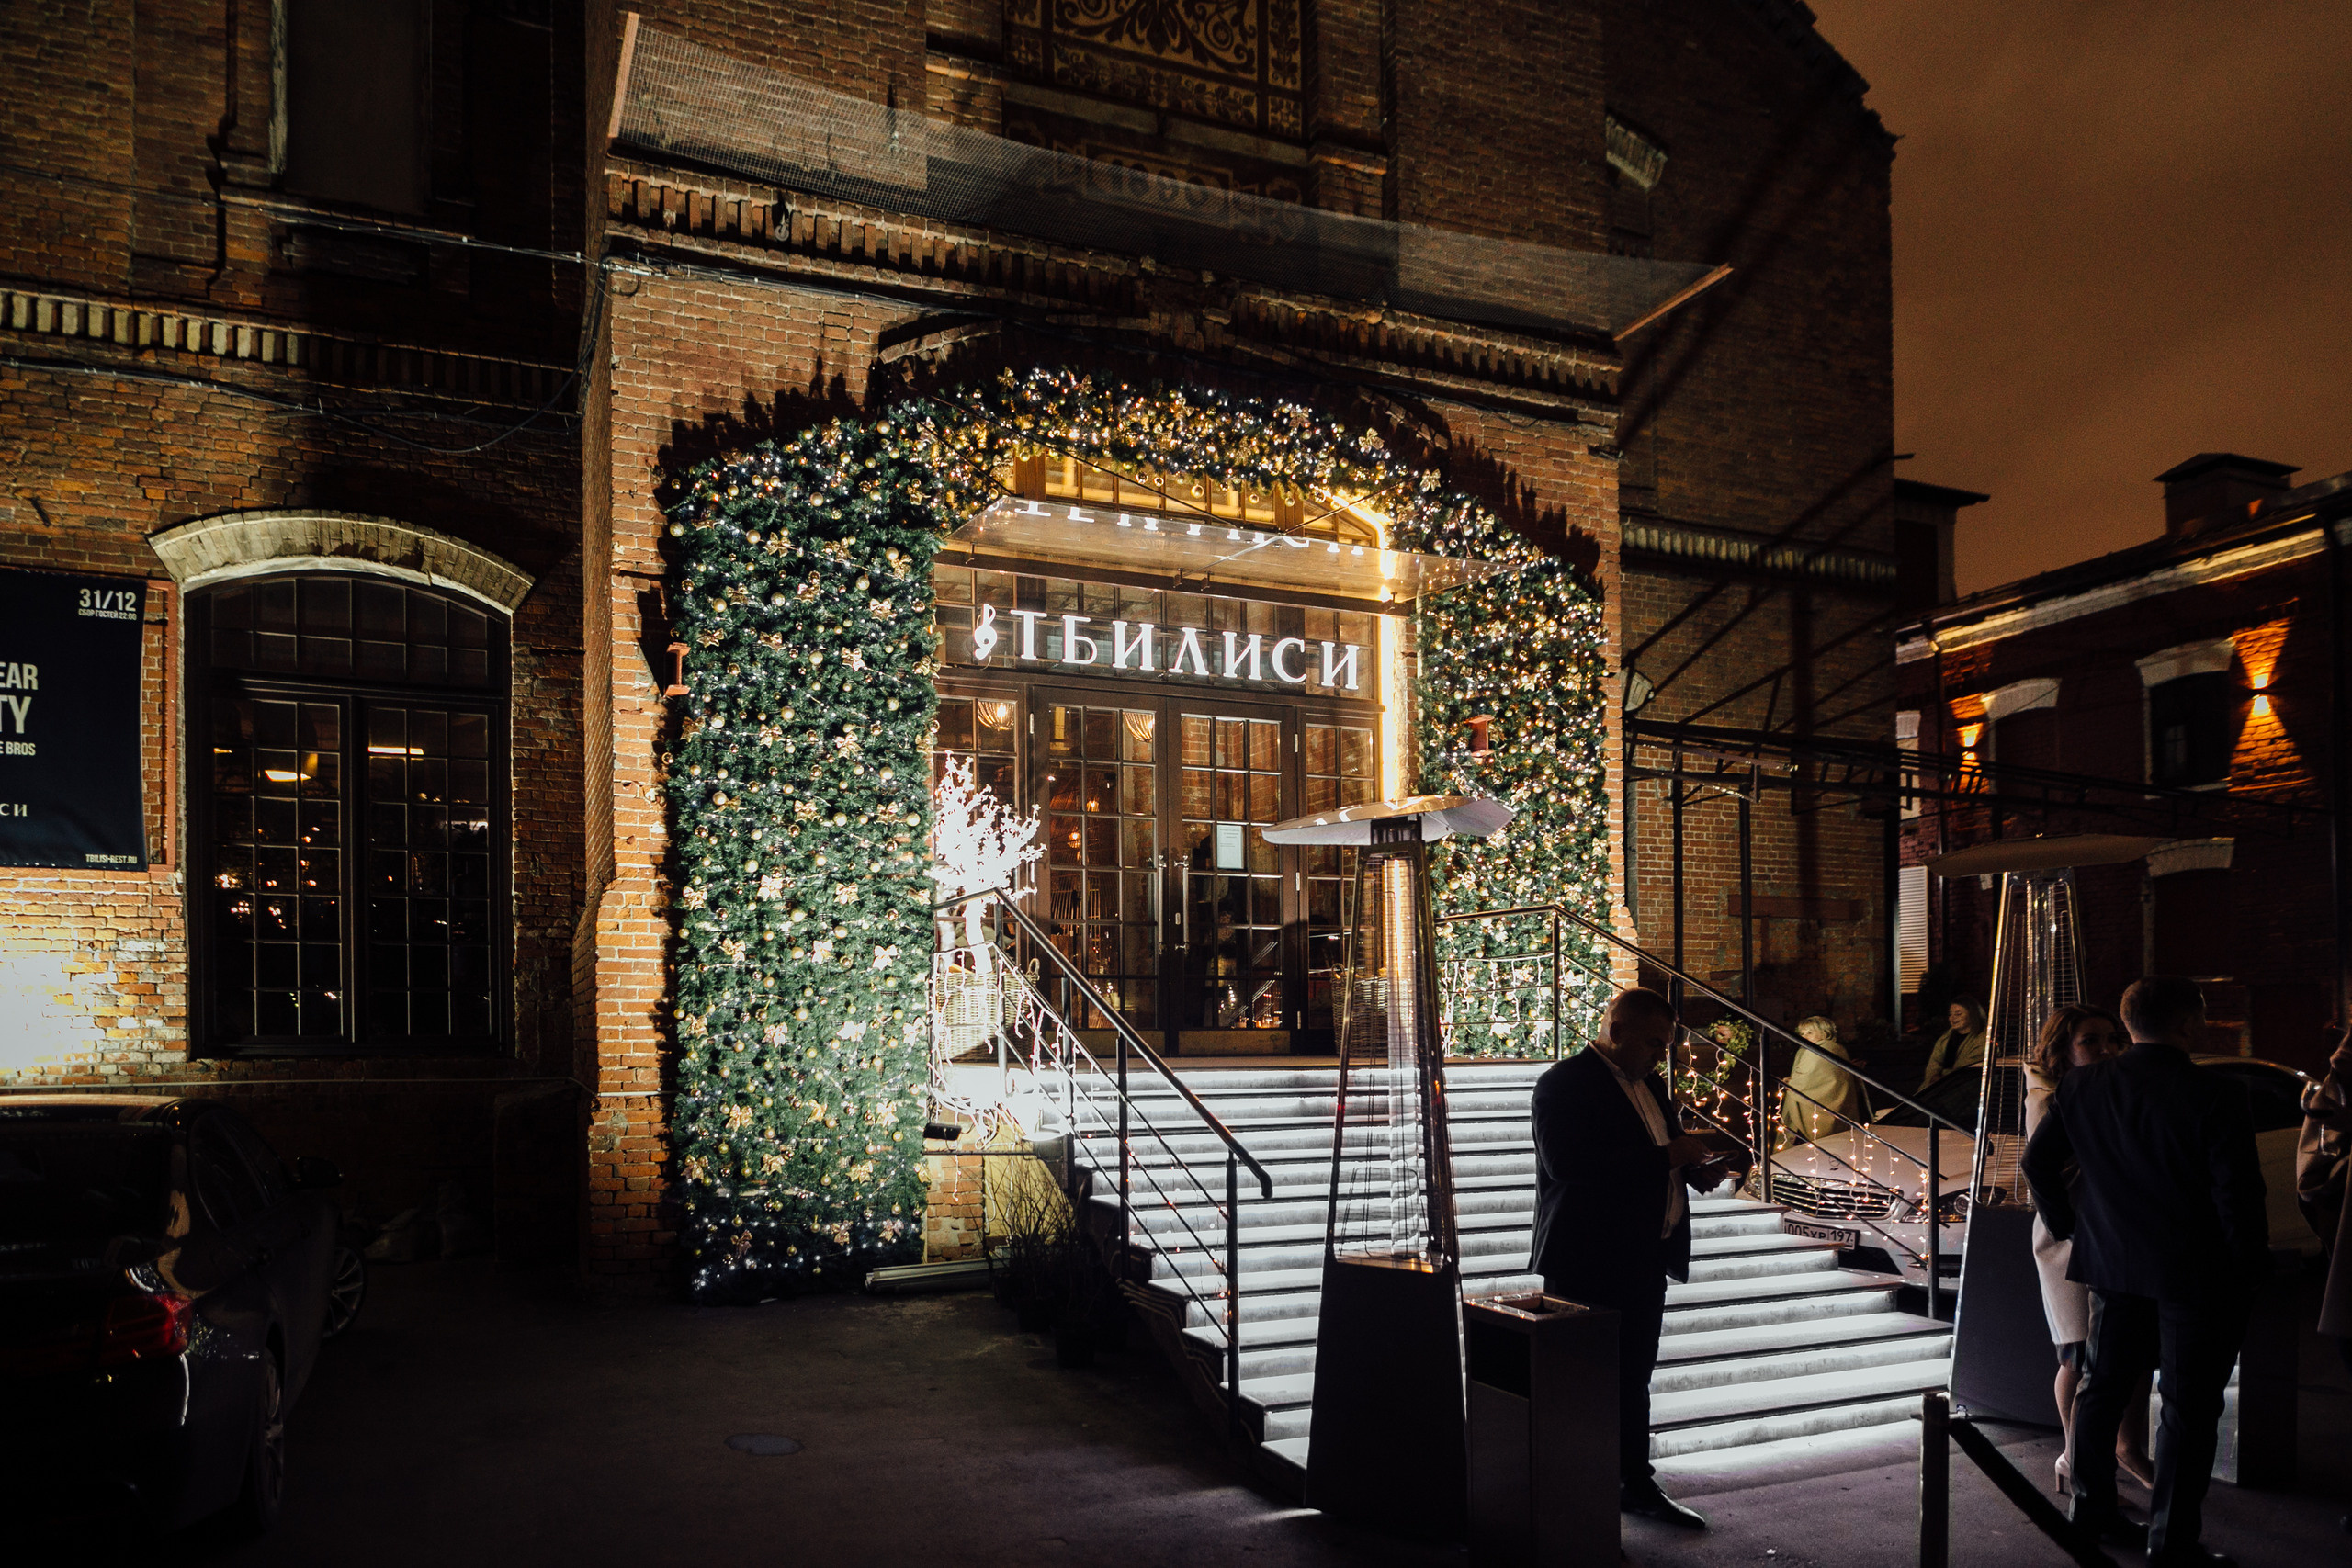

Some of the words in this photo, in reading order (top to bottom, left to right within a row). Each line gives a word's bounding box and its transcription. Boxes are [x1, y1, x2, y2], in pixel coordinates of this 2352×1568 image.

[79, 588, 137, 612] 31/12
[1011, 610, 1360, 690] ТБИЛИСИ
[6, 741, 36, 756] BROS
[85, 853, 138, 864] TBILISI-REST.RU
